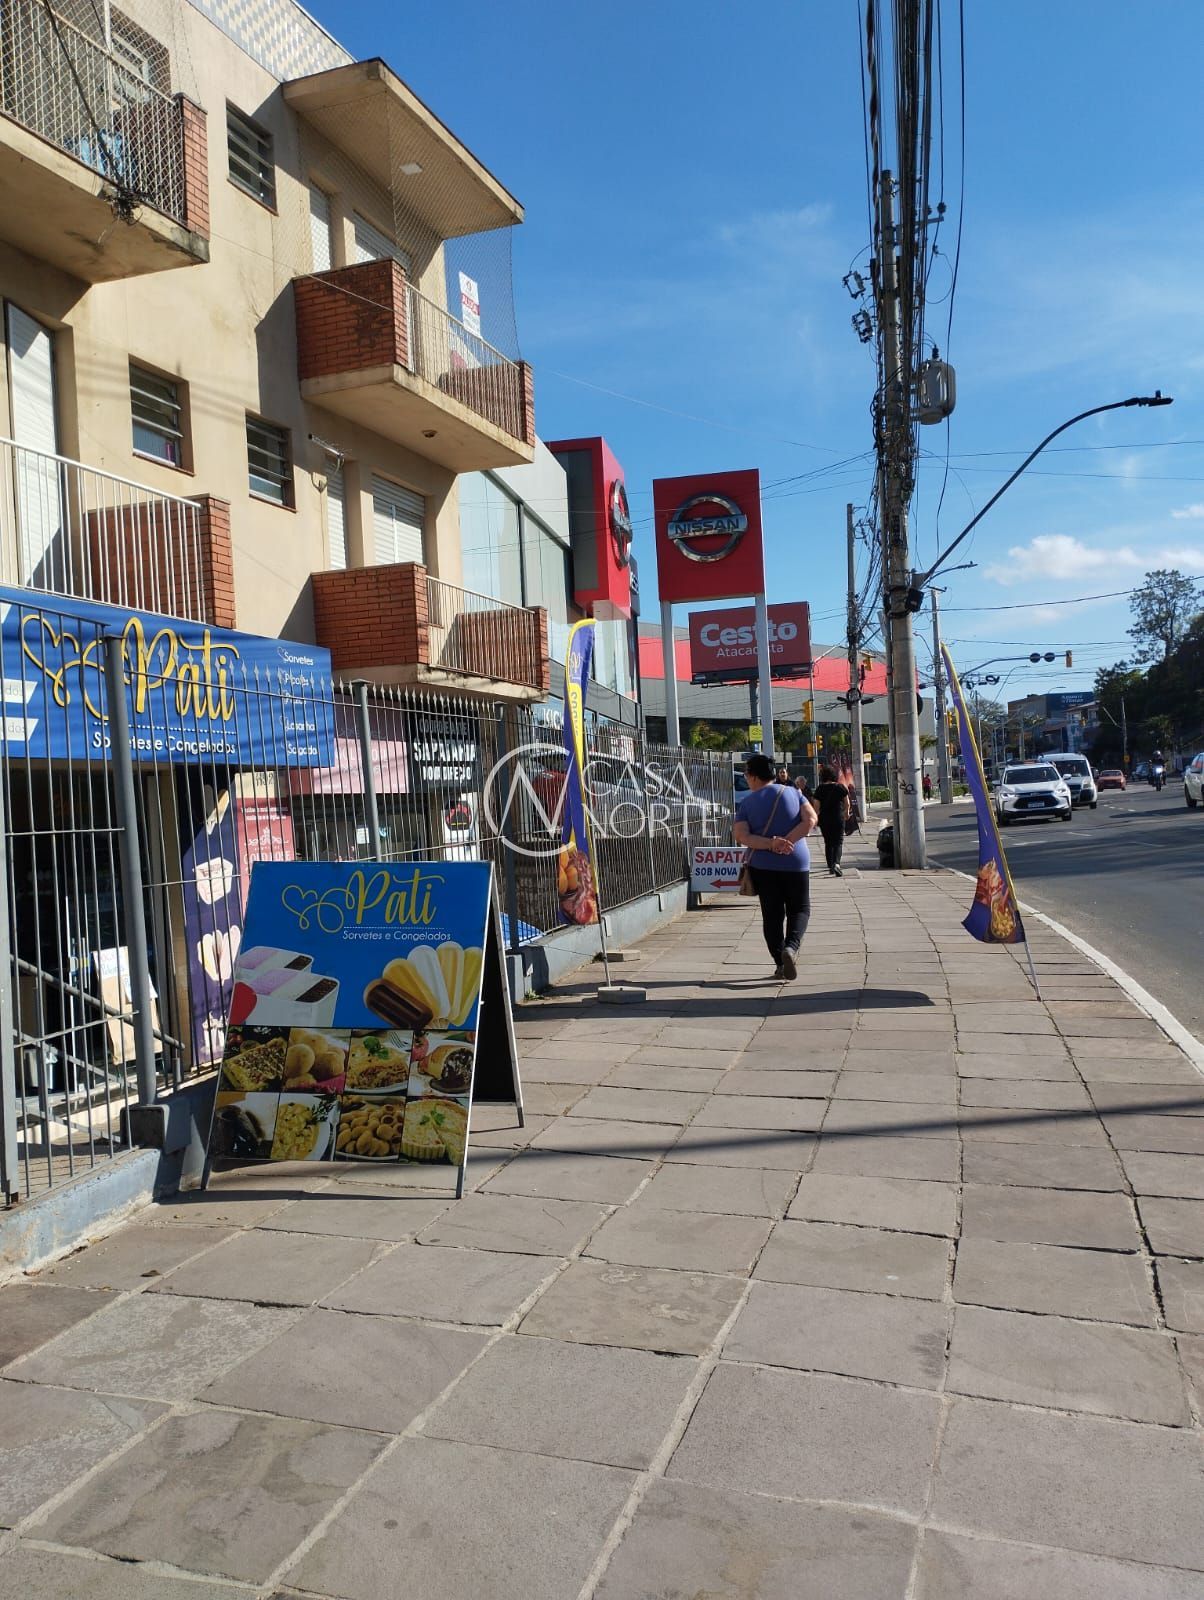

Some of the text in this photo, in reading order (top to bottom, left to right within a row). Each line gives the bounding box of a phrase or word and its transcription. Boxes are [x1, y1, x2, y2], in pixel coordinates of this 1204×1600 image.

[675, 518, 740, 535] NISSAN
[284, 652, 314, 666] Sorvetes
[121, 617, 240, 721] Pati
[154, 738, 163, 751] e
[165, 736, 236, 755] Congelados
[695, 867, 738, 877] SOB NOVA
[345, 868, 445, 925] Pati
[342, 930, 452, 942] Sorvetes e Congelados
